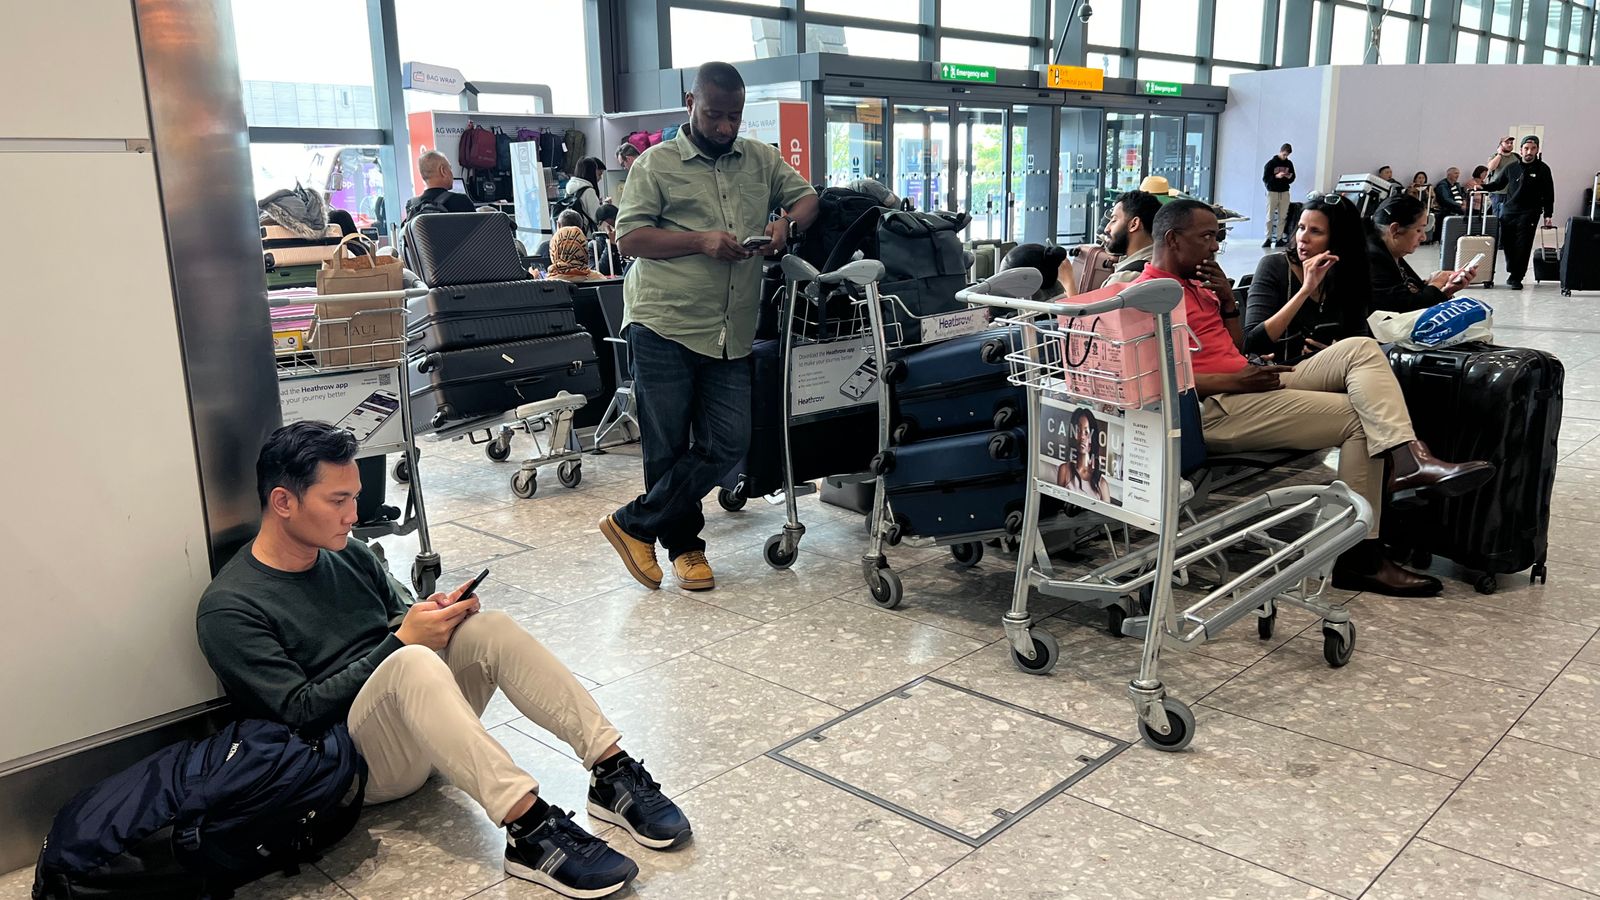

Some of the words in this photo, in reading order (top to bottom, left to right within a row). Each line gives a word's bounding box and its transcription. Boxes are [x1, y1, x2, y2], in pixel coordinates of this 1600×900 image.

[956, 69, 979, 79] Emergency
[760, 120, 776, 128] WRAP
[790, 138, 802, 170] ap
[939, 315, 972, 329] Heathrow
[301, 383, 334, 393] Heathrow
[336, 382, 349, 391] app
[285, 397, 302, 405] your
[302, 393, 326, 403] journey
[327, 390, 346, 399] better
[1047, 417, 1078, 440] CAN
[1047, 441, 1077, 464] SEE
